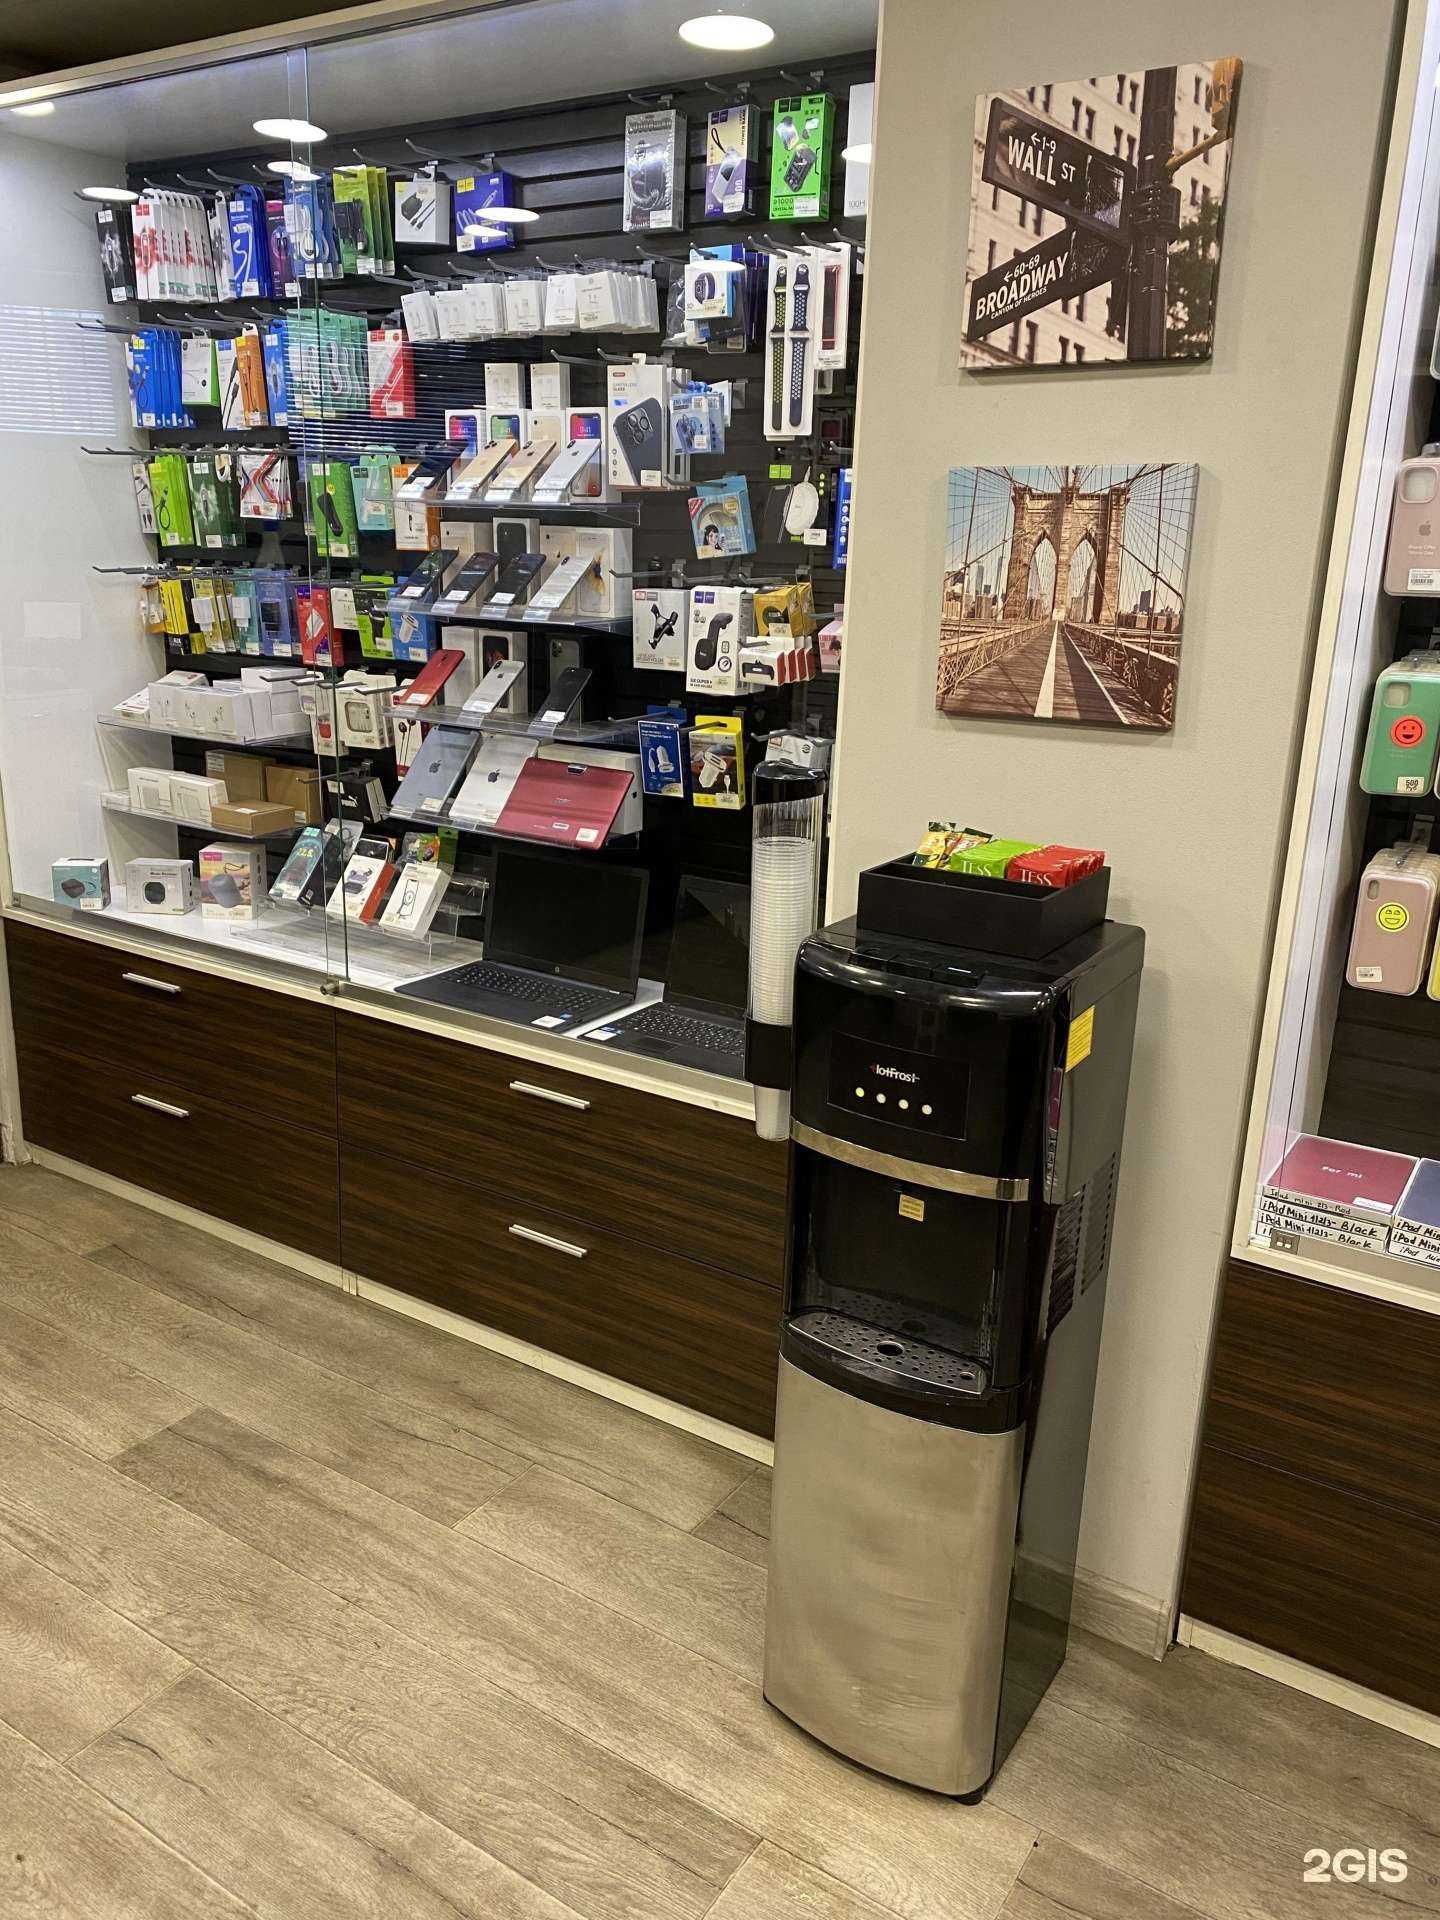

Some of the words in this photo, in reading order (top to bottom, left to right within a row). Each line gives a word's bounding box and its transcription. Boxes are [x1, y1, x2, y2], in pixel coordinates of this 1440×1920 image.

[1042, 136, 1057, 154] 1-9
[1008, 135, 1056, 186] WALL
[1061, 162, 1076, 182] ST
[1014, 254, 1040, 278] 60-69
[975, 251, 1069, 320] BROADWAY
[990, 303, 1014, 320] CANYON
[1014, 299, 1023, 308] OF
[1023, 286, 1047, 303] HEROES
[961, 860, 992, 877] TESS
[1019, 868, 1052, 886] TESS
[1340, 1221, 1378, 1237] Black
